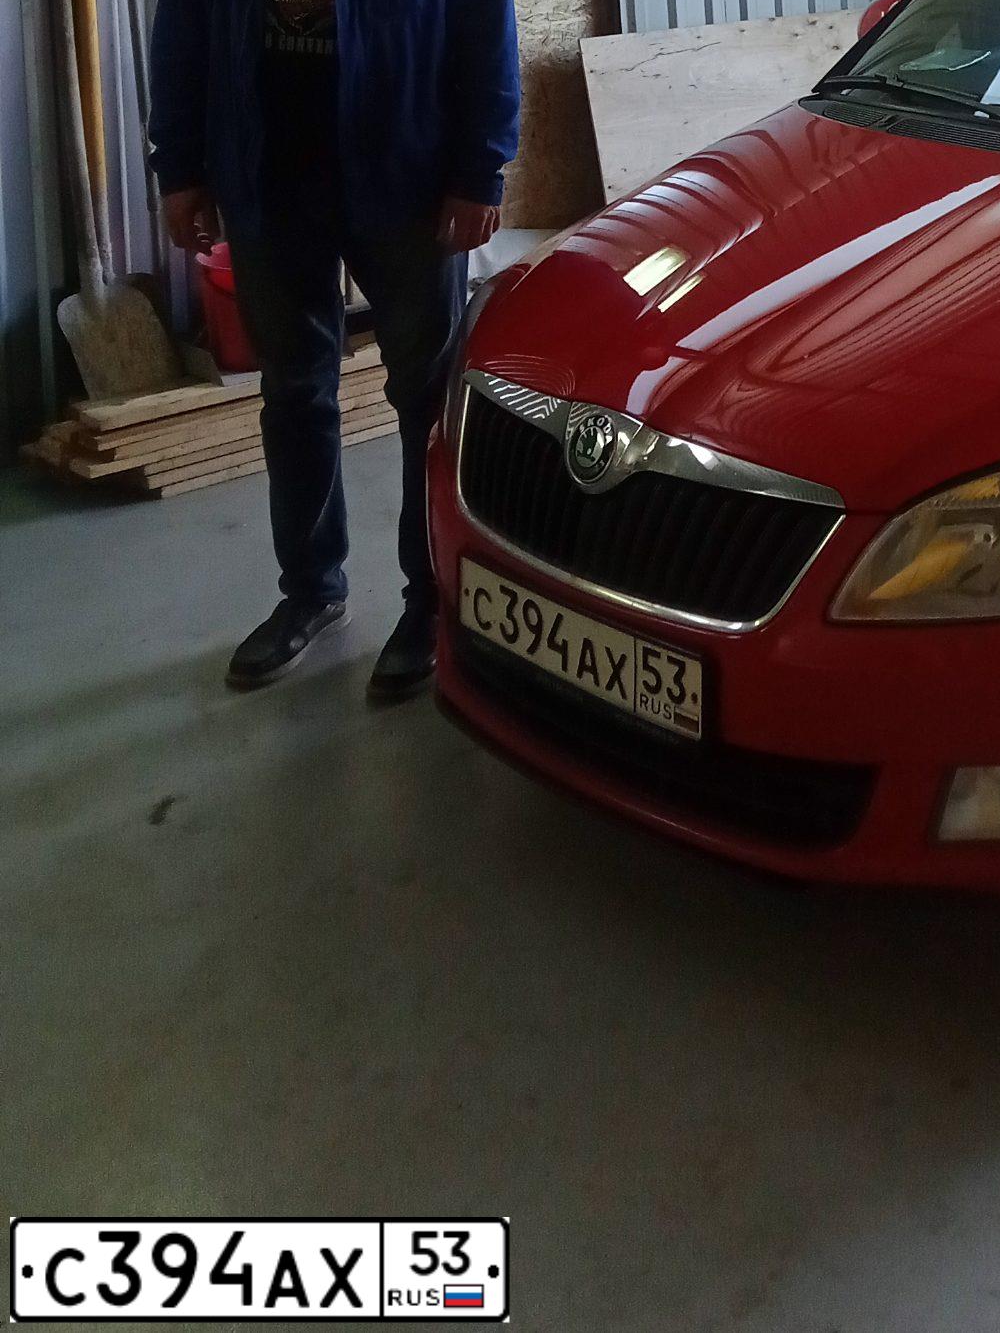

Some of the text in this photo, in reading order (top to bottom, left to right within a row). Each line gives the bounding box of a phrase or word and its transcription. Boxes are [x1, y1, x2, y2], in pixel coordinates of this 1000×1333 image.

[473, 584, 686, 704] С394АХ 53
[639, 693, 673, 720] RUS
